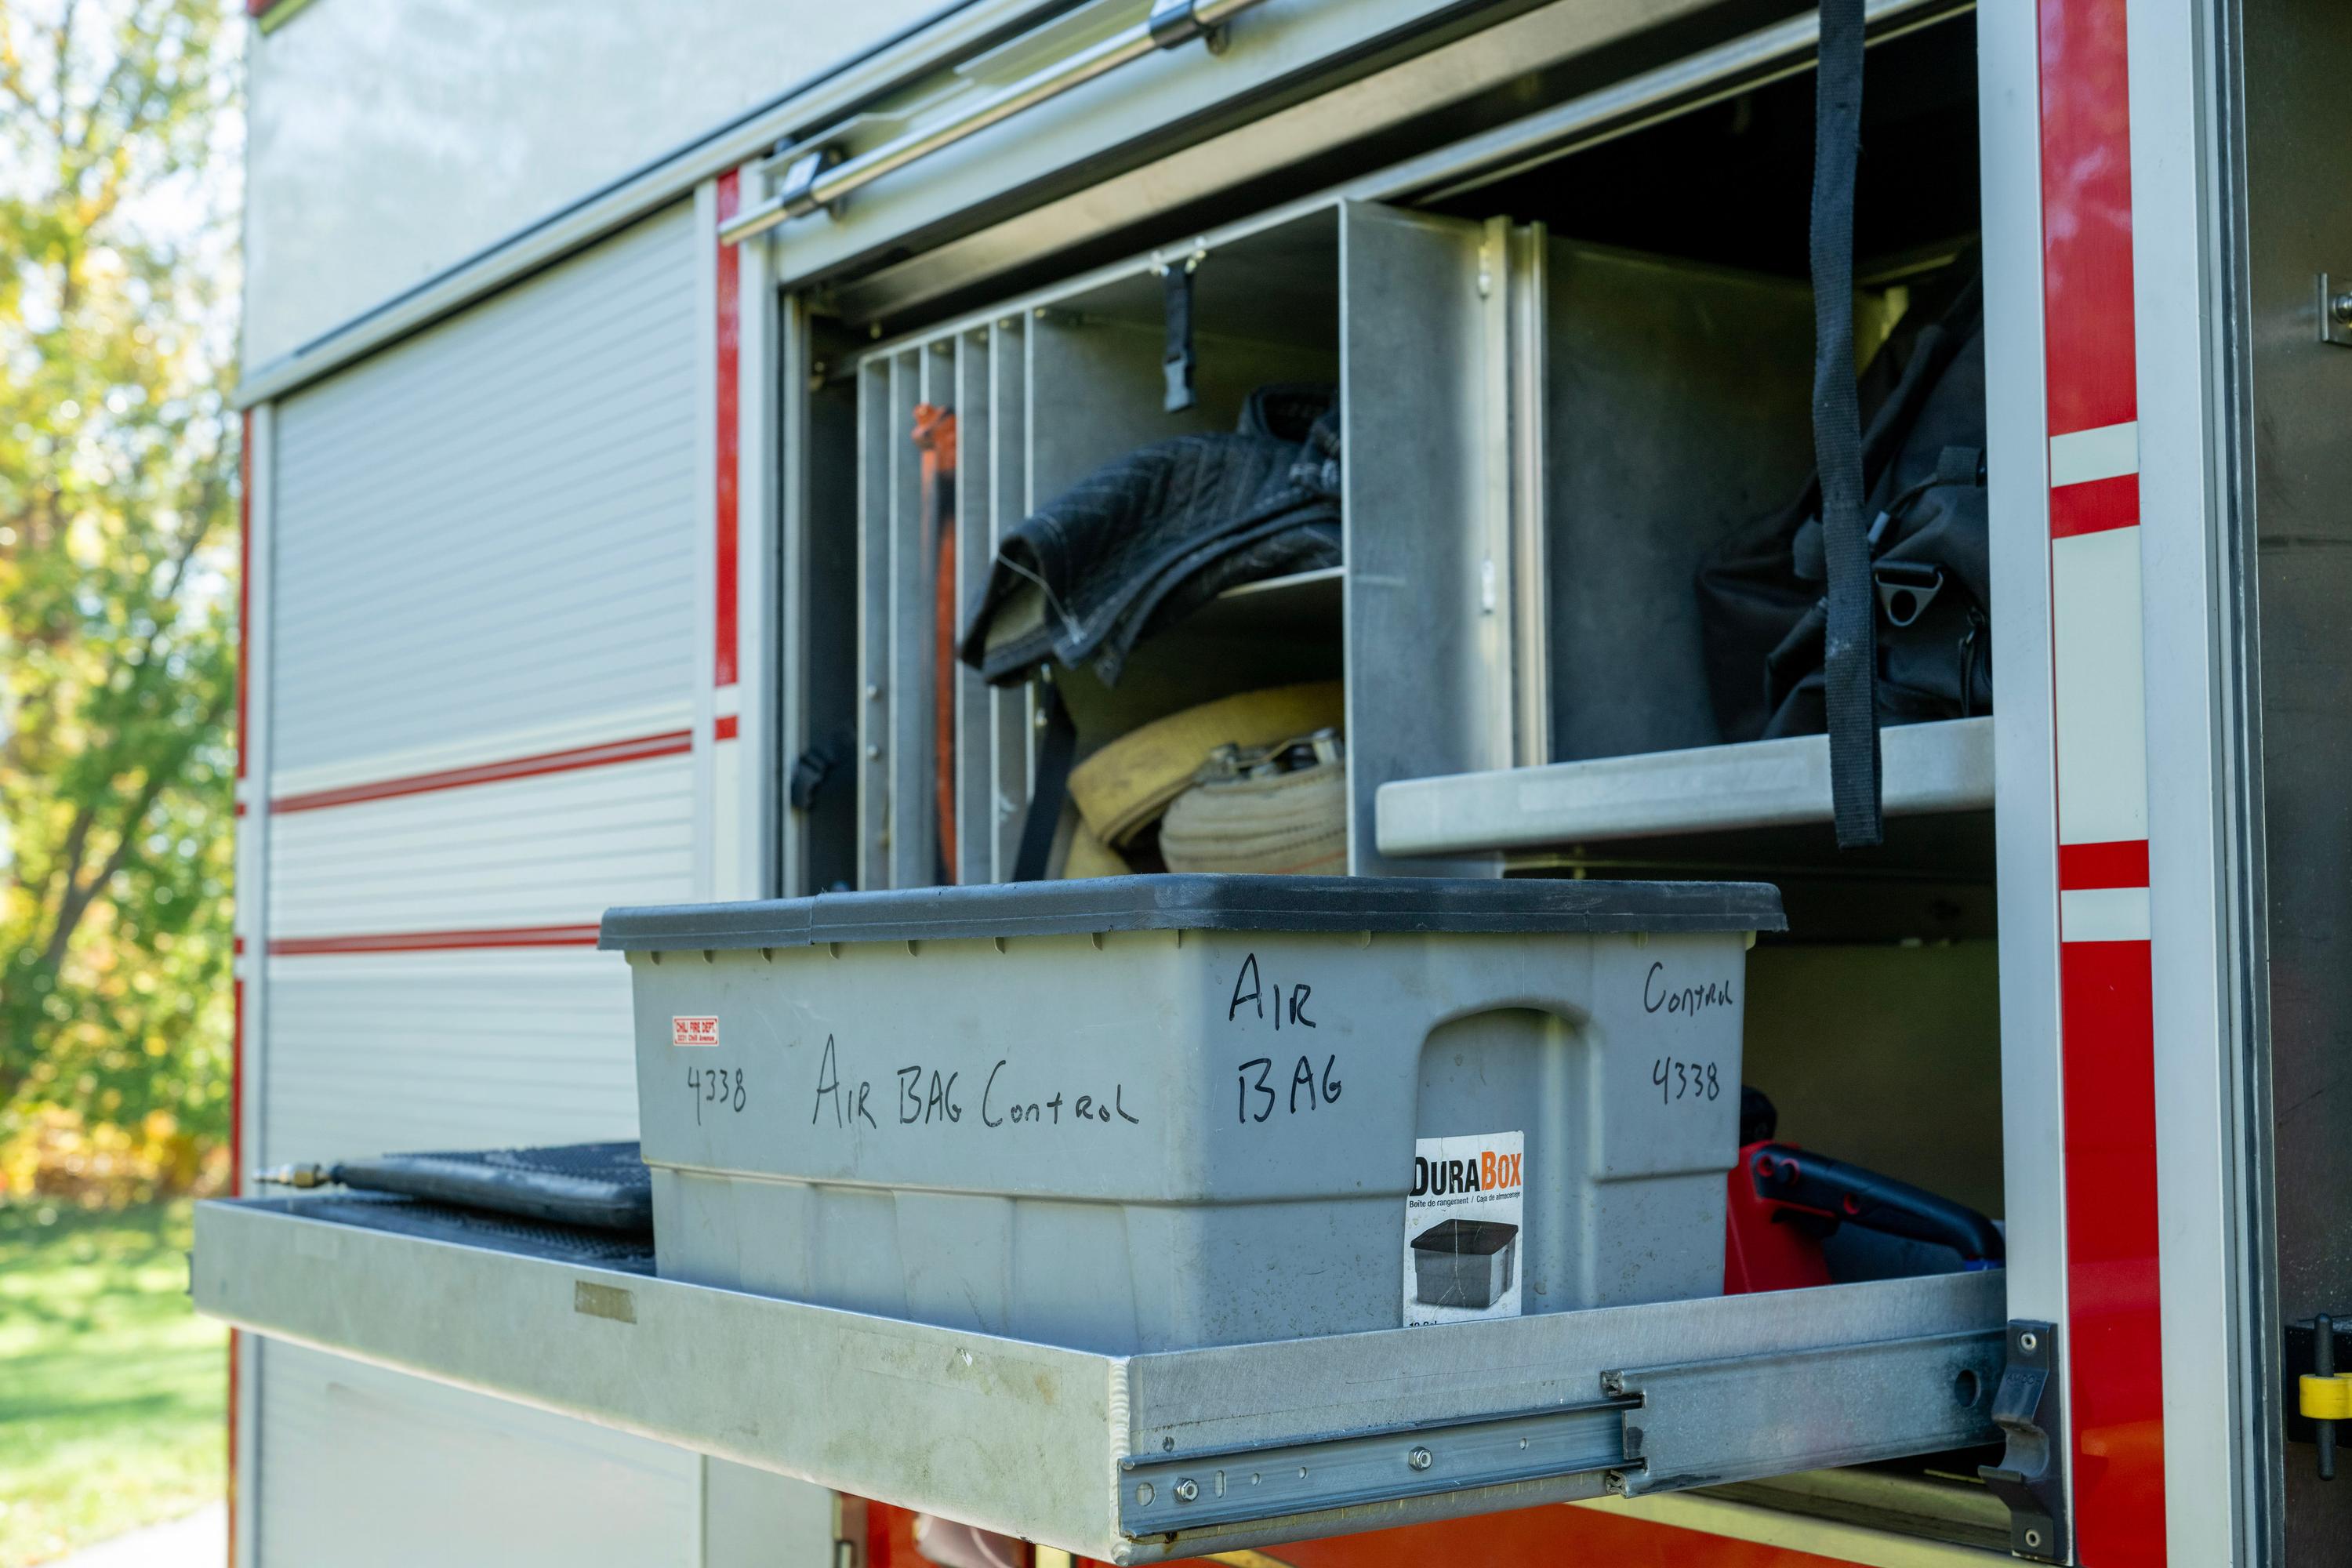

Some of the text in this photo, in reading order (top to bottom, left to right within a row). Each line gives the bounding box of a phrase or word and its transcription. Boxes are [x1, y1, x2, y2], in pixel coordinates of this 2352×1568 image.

[690, 1022, 701, 1033] FIRE
[687, 1066, 746, 1127] 4338
[897, 1065, 962, 1124] BAG
[1238, 1054, 1342, 1124] BAG
[1653, 1056, 1720, 1105] 4338
[1409, 1200, 1426, 1208] Boîte
[1436, 1196, 1469, 1207] rangement
